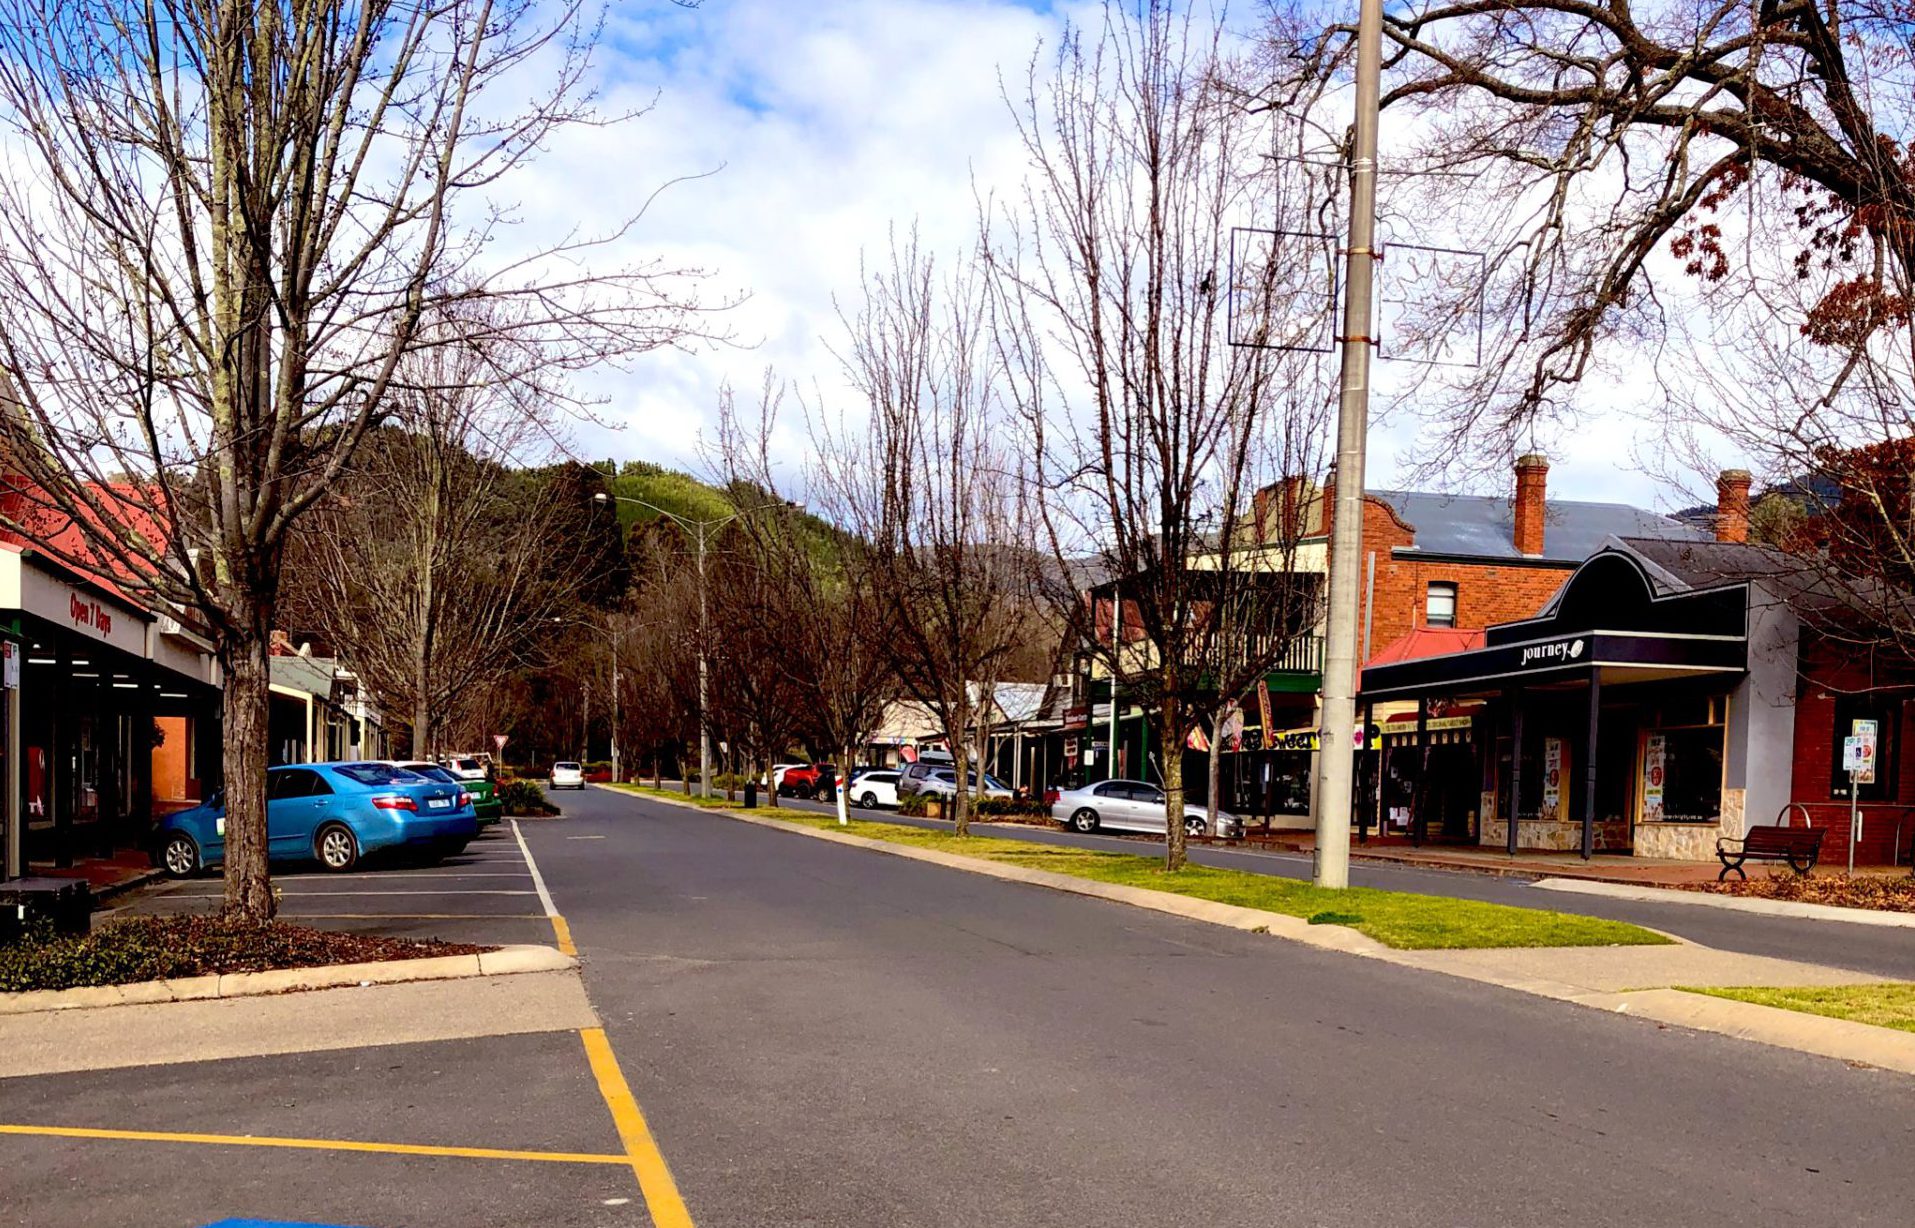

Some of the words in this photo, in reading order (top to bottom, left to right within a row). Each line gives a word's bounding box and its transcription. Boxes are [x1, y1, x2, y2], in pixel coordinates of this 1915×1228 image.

[70, 592, 89, 626] Open
[90, 602, 95, 626] 7
[96, 605, 111, 638] Days
[1521, 643, 1568, 666] journey
